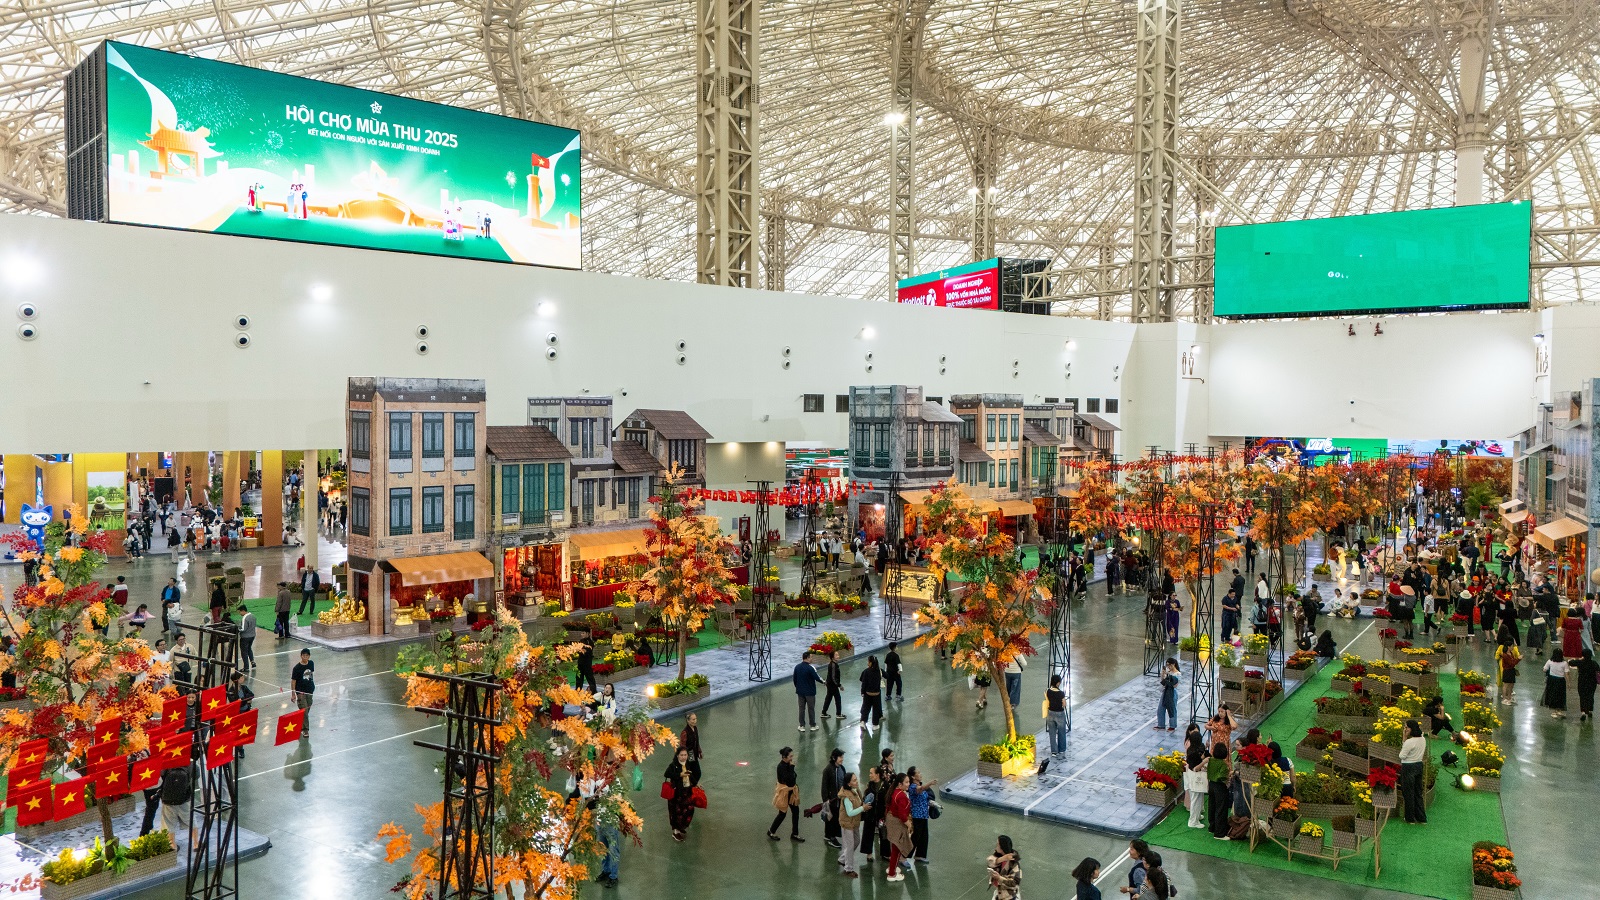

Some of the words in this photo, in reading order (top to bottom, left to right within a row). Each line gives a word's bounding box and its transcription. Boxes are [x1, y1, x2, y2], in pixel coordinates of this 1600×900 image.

[286, 104, 314, 124] HỘI
[319, 111, 352, 131] CHỢ
[356, 117, 390, 137] MÙA
[393, 124, 420, 141] THU
[425, 130, 458, 148] 2025
[307, 128, 319, 136] KẾT
[406, 145, 420, 153] KINH
[421, 147, 440, 156] DOANH
[946, 291, 960, 301] 100%
